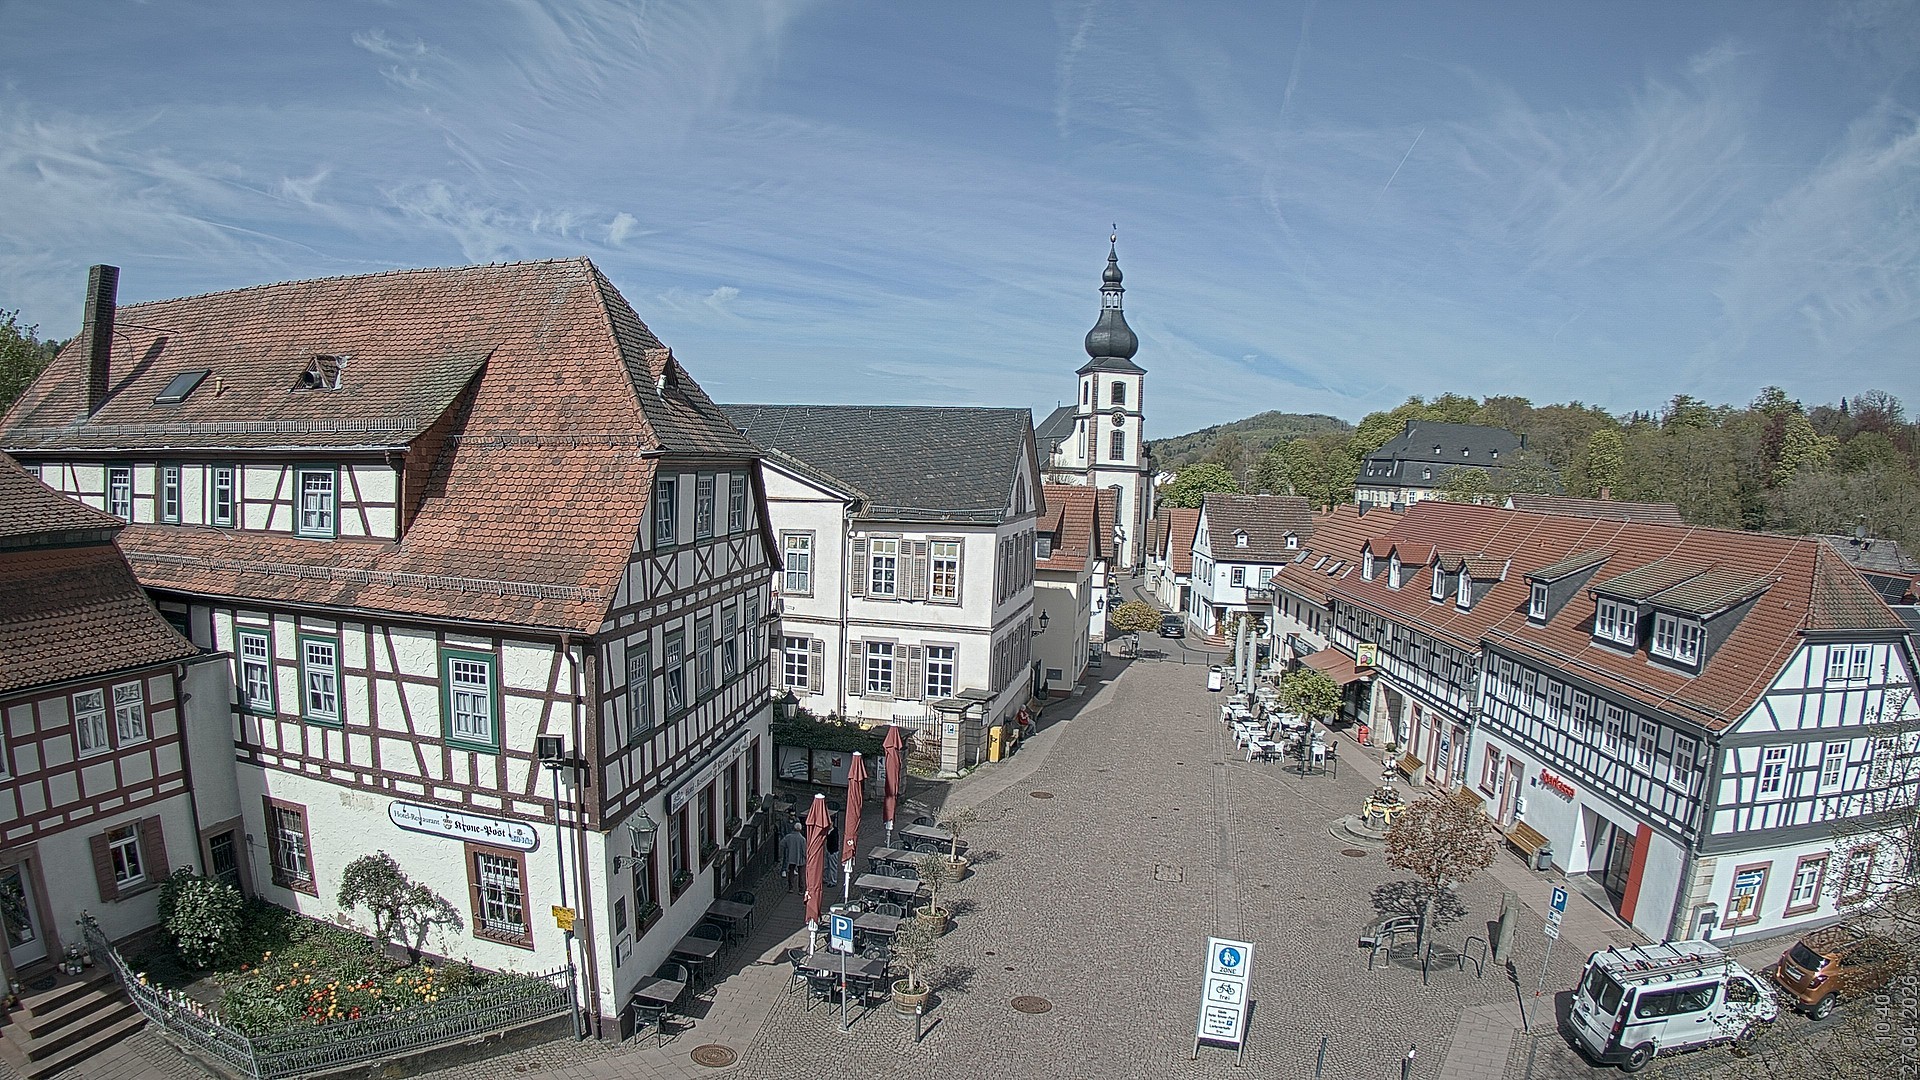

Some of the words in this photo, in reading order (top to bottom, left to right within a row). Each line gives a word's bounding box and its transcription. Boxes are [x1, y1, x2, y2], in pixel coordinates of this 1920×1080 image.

[1539, 768, 1576, 799] Sparkasse
[454, 820, 506, 838] Krone-Post
[1553, 890, 1564, 907] P
[836, 918, 848, 936] P
[1219, 966, 1237, 974] ZONE
